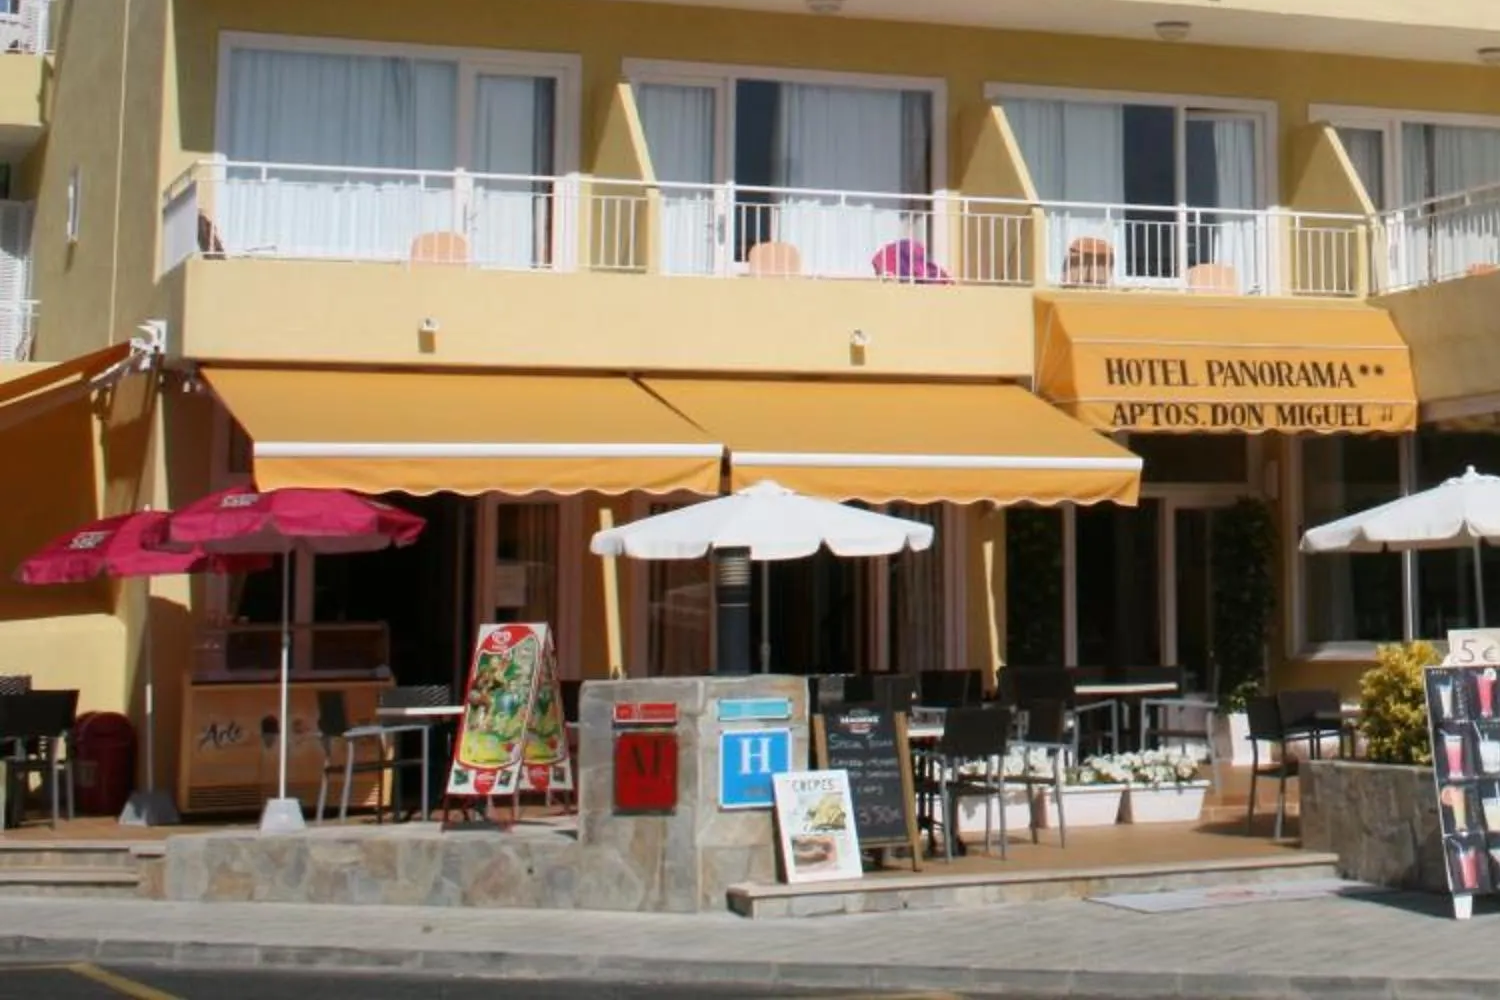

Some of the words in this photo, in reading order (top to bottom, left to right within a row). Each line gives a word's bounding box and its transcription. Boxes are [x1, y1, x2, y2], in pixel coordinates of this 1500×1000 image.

[1105, 357, 1198, 387] HOTEL
[1206, 359, 1356, 389] PANORAMA
[1210, 403, 1265, 427] DON
[1275, 404, 1371, 427] MIGUEL
[738, 737, 772, 776] H
